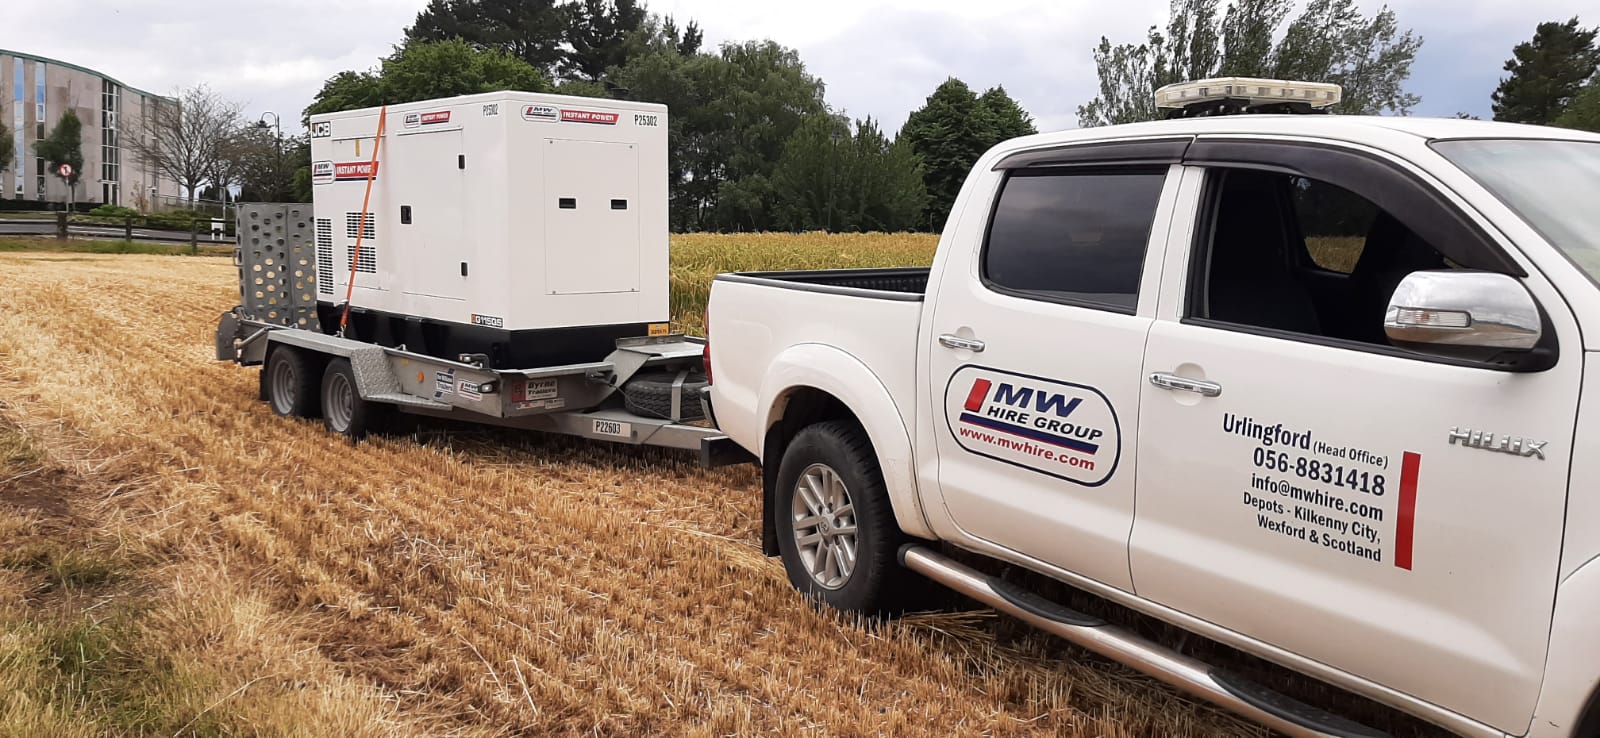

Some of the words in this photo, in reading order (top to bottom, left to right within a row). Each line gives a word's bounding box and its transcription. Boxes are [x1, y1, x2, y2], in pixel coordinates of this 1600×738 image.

[312, 121, 331, 138] JCB
[563, 111, 590, 119] INSTANT
[592, 113, 614, 121] POWER
[634, 114, 658, 126] P25302
[337, 165, 356, 175] INSTANT
[357, 164, 375, 174] POWE
[993, 382, 1084, 418] MW
[595, 420, 621, 434] P22603
[987, 406, 1030, 424] HIRE
[1034, 417, 1103, 441] GROUP
[1223, 412, 1312, 450] Urlingford
[1313, 441, 1346, 458] (Head
[1349, 448, 1389, 470] Office)
[959, 427, 1095, 471] www.mwhire.com
[1449, 426, 1548, 460] HILUX
[1253, 447, 1386, 496] 056-8831418
[1251, 473, 1383, 522] info@mwhire.com
[1243, 492, 1284, 515] Depots
[1294, 505, 1348, 535] Kilkenny
[1351, 521, 1381, 544] City,
[1257, 514, 1306, 540] Wexford
[1309, 529, 1319, 544] &
[1322, 533, 1381, 562] Scotland
